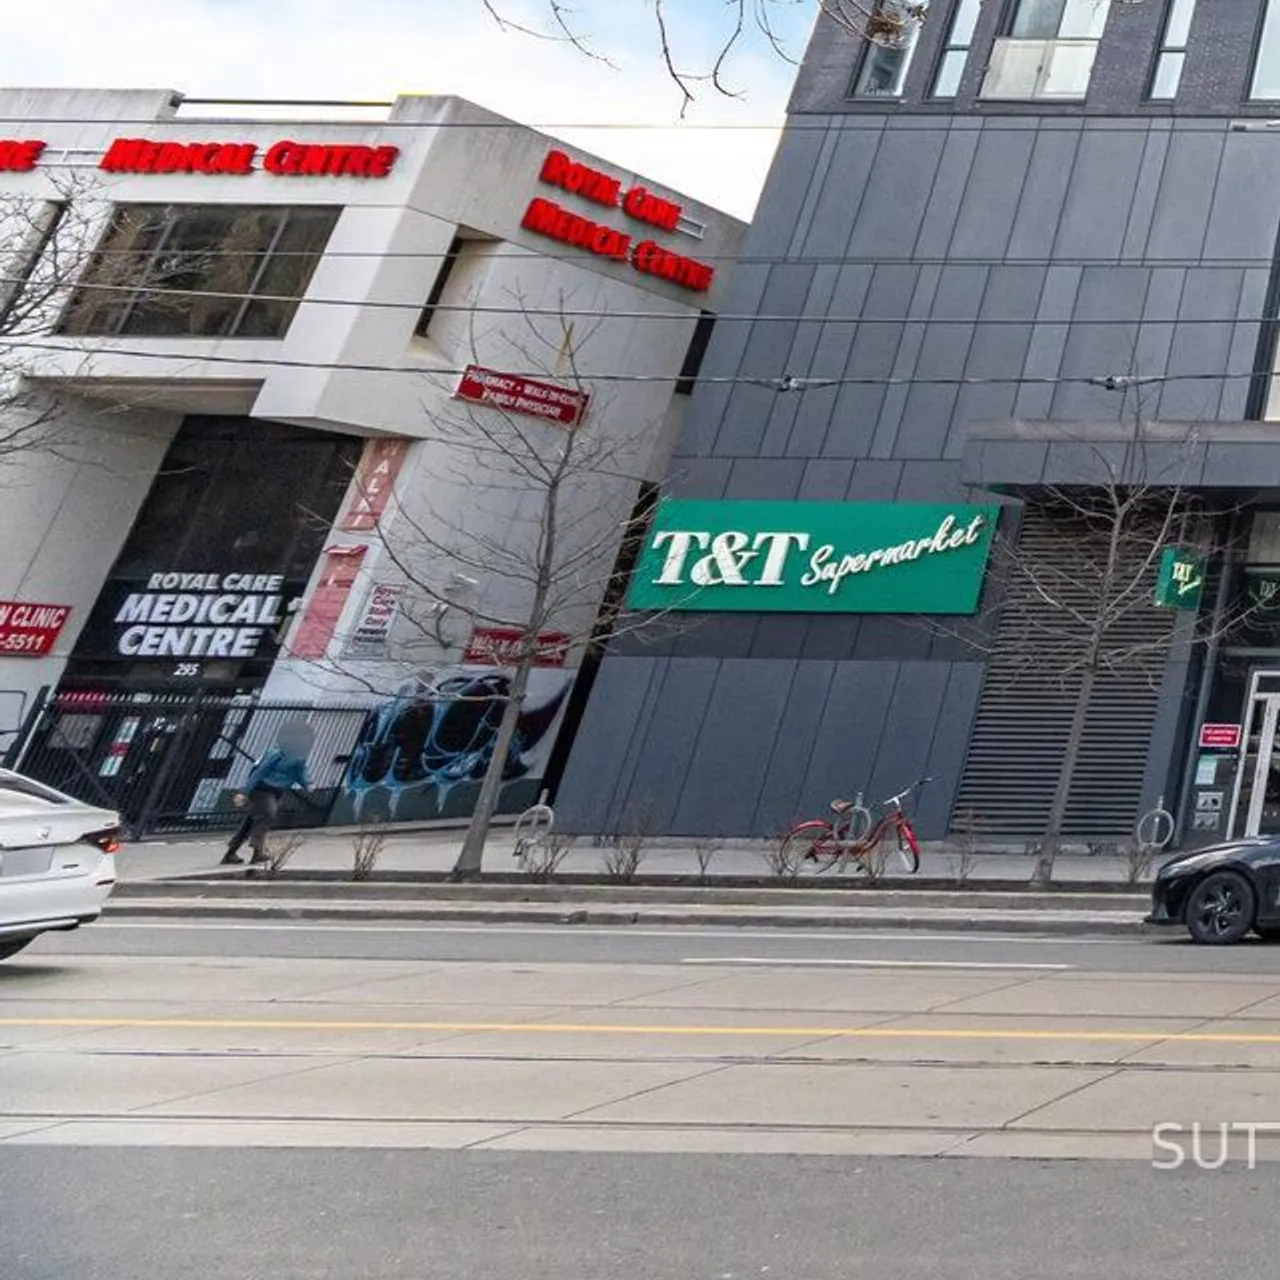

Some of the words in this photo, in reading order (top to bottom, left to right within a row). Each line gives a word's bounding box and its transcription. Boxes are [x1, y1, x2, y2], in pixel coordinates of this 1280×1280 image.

[263, 141, 399, 177] CENTRE
[652, 531, 810, 586] T&T
[800, 513, 985, 595] Supermarket
[147, 573, 219, 590] ROYAL
[222, 574, 284, 591] CARE
[11, 606, 66, 629] CLINIC
[114, 594, 282, 624] MEDICAL
[118, 627, 264, 656] CENTRE
[173, 664, 199, 676] 295
